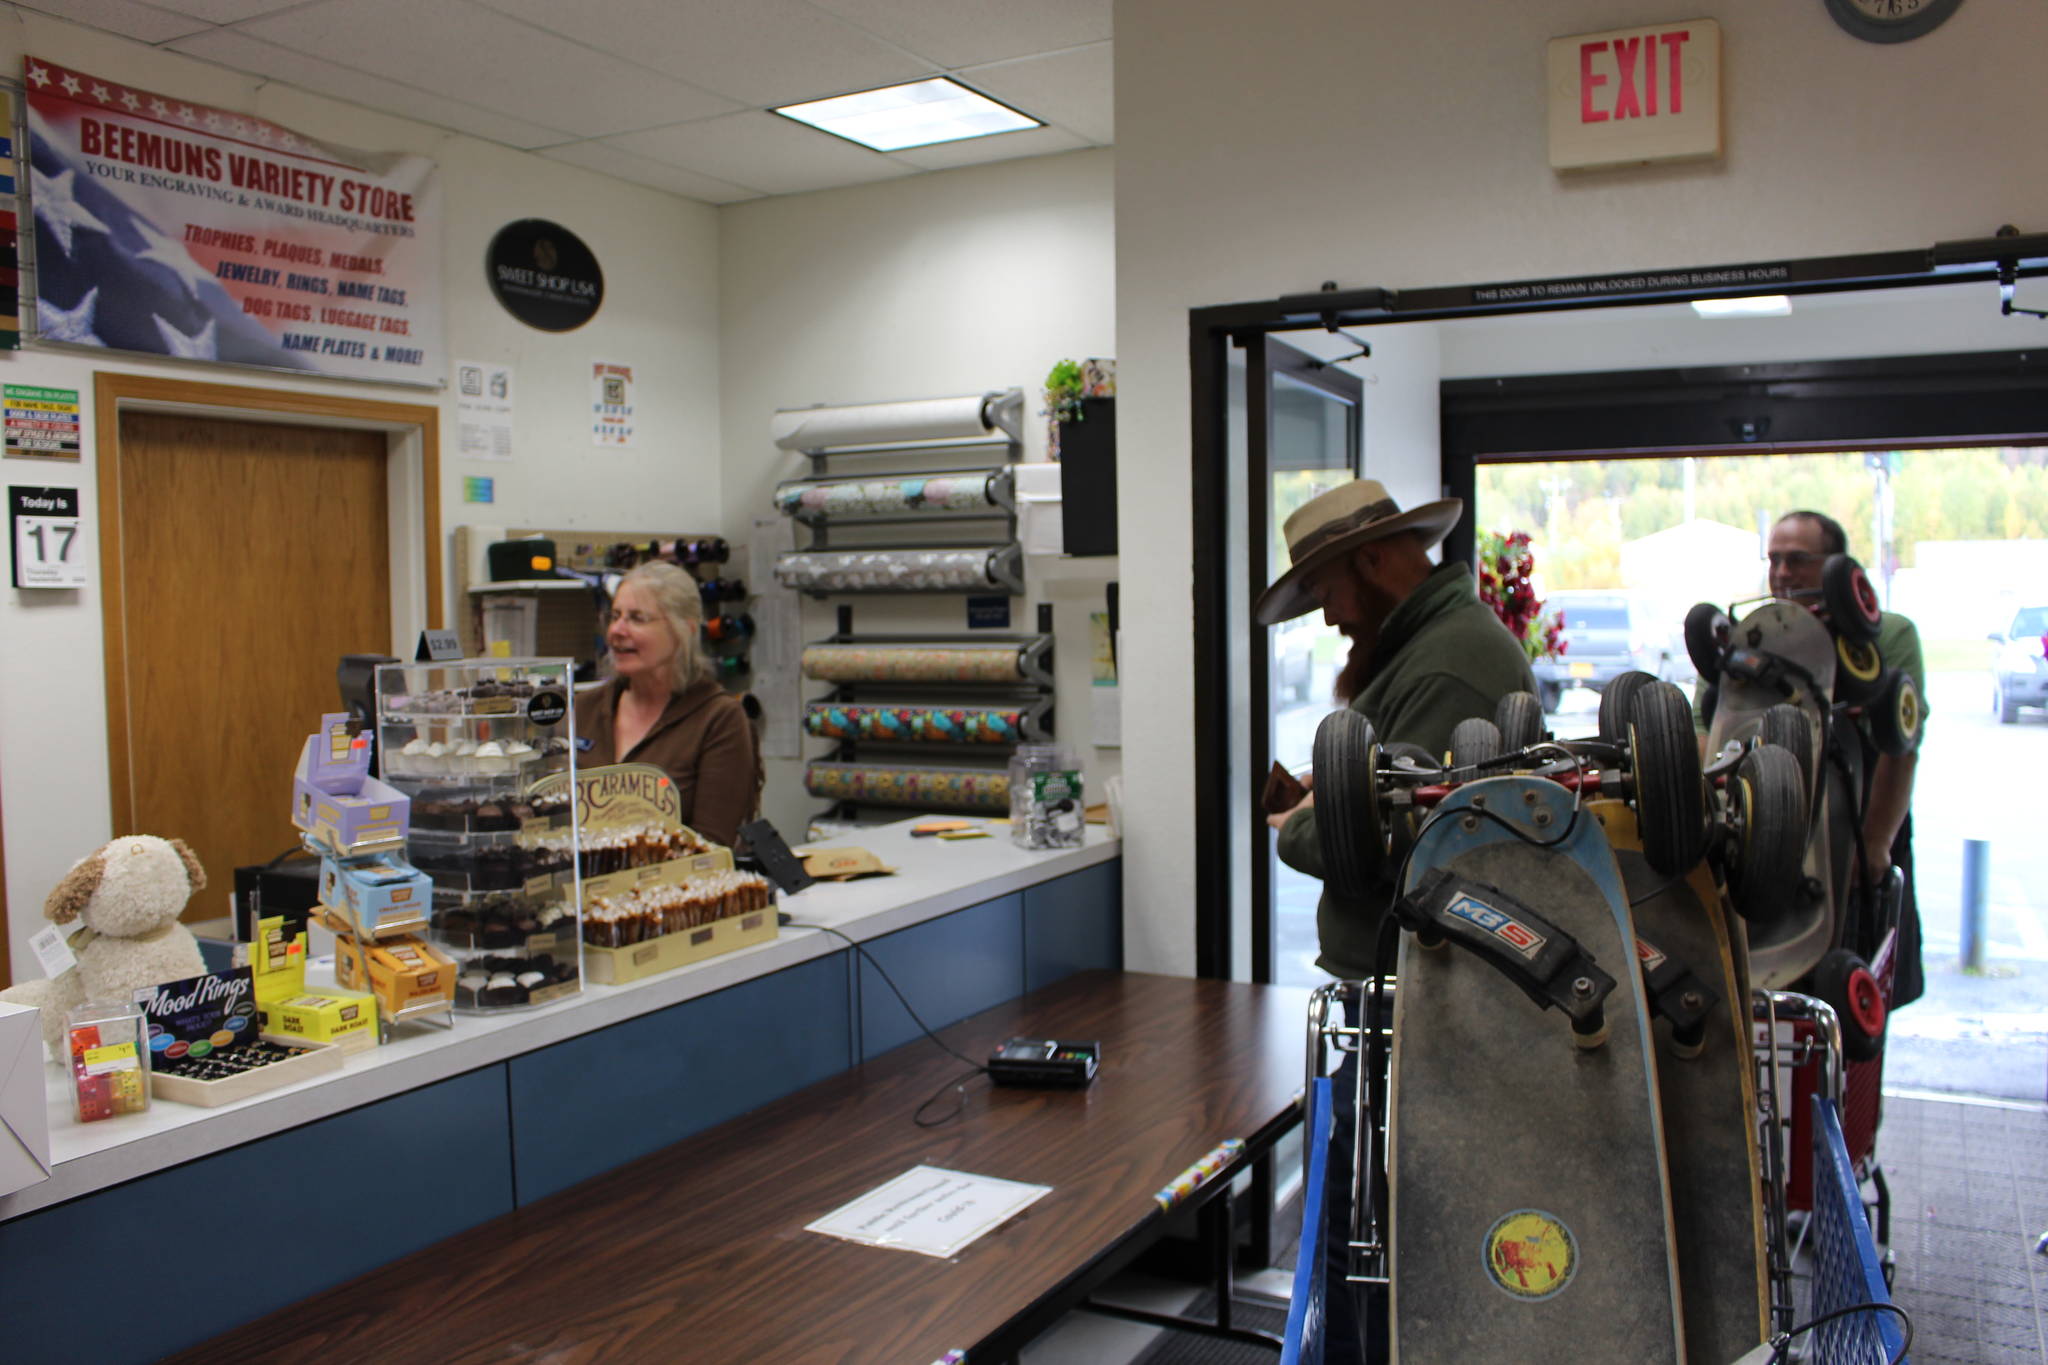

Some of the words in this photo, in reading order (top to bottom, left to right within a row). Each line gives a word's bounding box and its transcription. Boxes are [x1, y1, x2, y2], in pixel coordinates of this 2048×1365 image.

[1580, 30, 1690, 124] EXIT
[81, 117, 222, 183] BEEMUNS
[228, 153, 335, 207] VARIETY
[340, 179, 416, 222] STORE
[86, 161, 136, 184] YOUR
[140, 173, 234, 203] ENGRAVING
[238, 193, 249, 207] &
[254, 197, 304, 218] AWARD
[306, 208, 416, 238] HEADQUARTERS
[337, 280, 375, 301] NAME
[1475, 289, 1498, 300] THIS
[1499, 287, 1530, 298] DOOR
[1532, 285, 1546, 296] TO
[1548, 282, 1587, 295] REMAIN
[1588, 277, 1646, 291] UNLOCKED
[1647, 274, 1689, 287] DURING
[1691, 270, 1746, 283] BUSINESS
[1748, 267, 1788, 279] HOURS
[242, 297, 273, 316] DOG
[320, 307, 376, 330] LUGGAGE
[281, 333, 321, 353] NAME
[321, 339, 366, 358] PLATES
[370, 347, 379, 359] &
[385, 347, 424, 365] MORE!
[21, 496, 55, 511] Today
[27, 525, 77, 562] 17
[587, 773, 675, 816] CARAMELS
[144, 977, 204, 1017] Mood
[198, 975, 250, 1016] Rings
[330, 1025, 348, 1035] DARK
